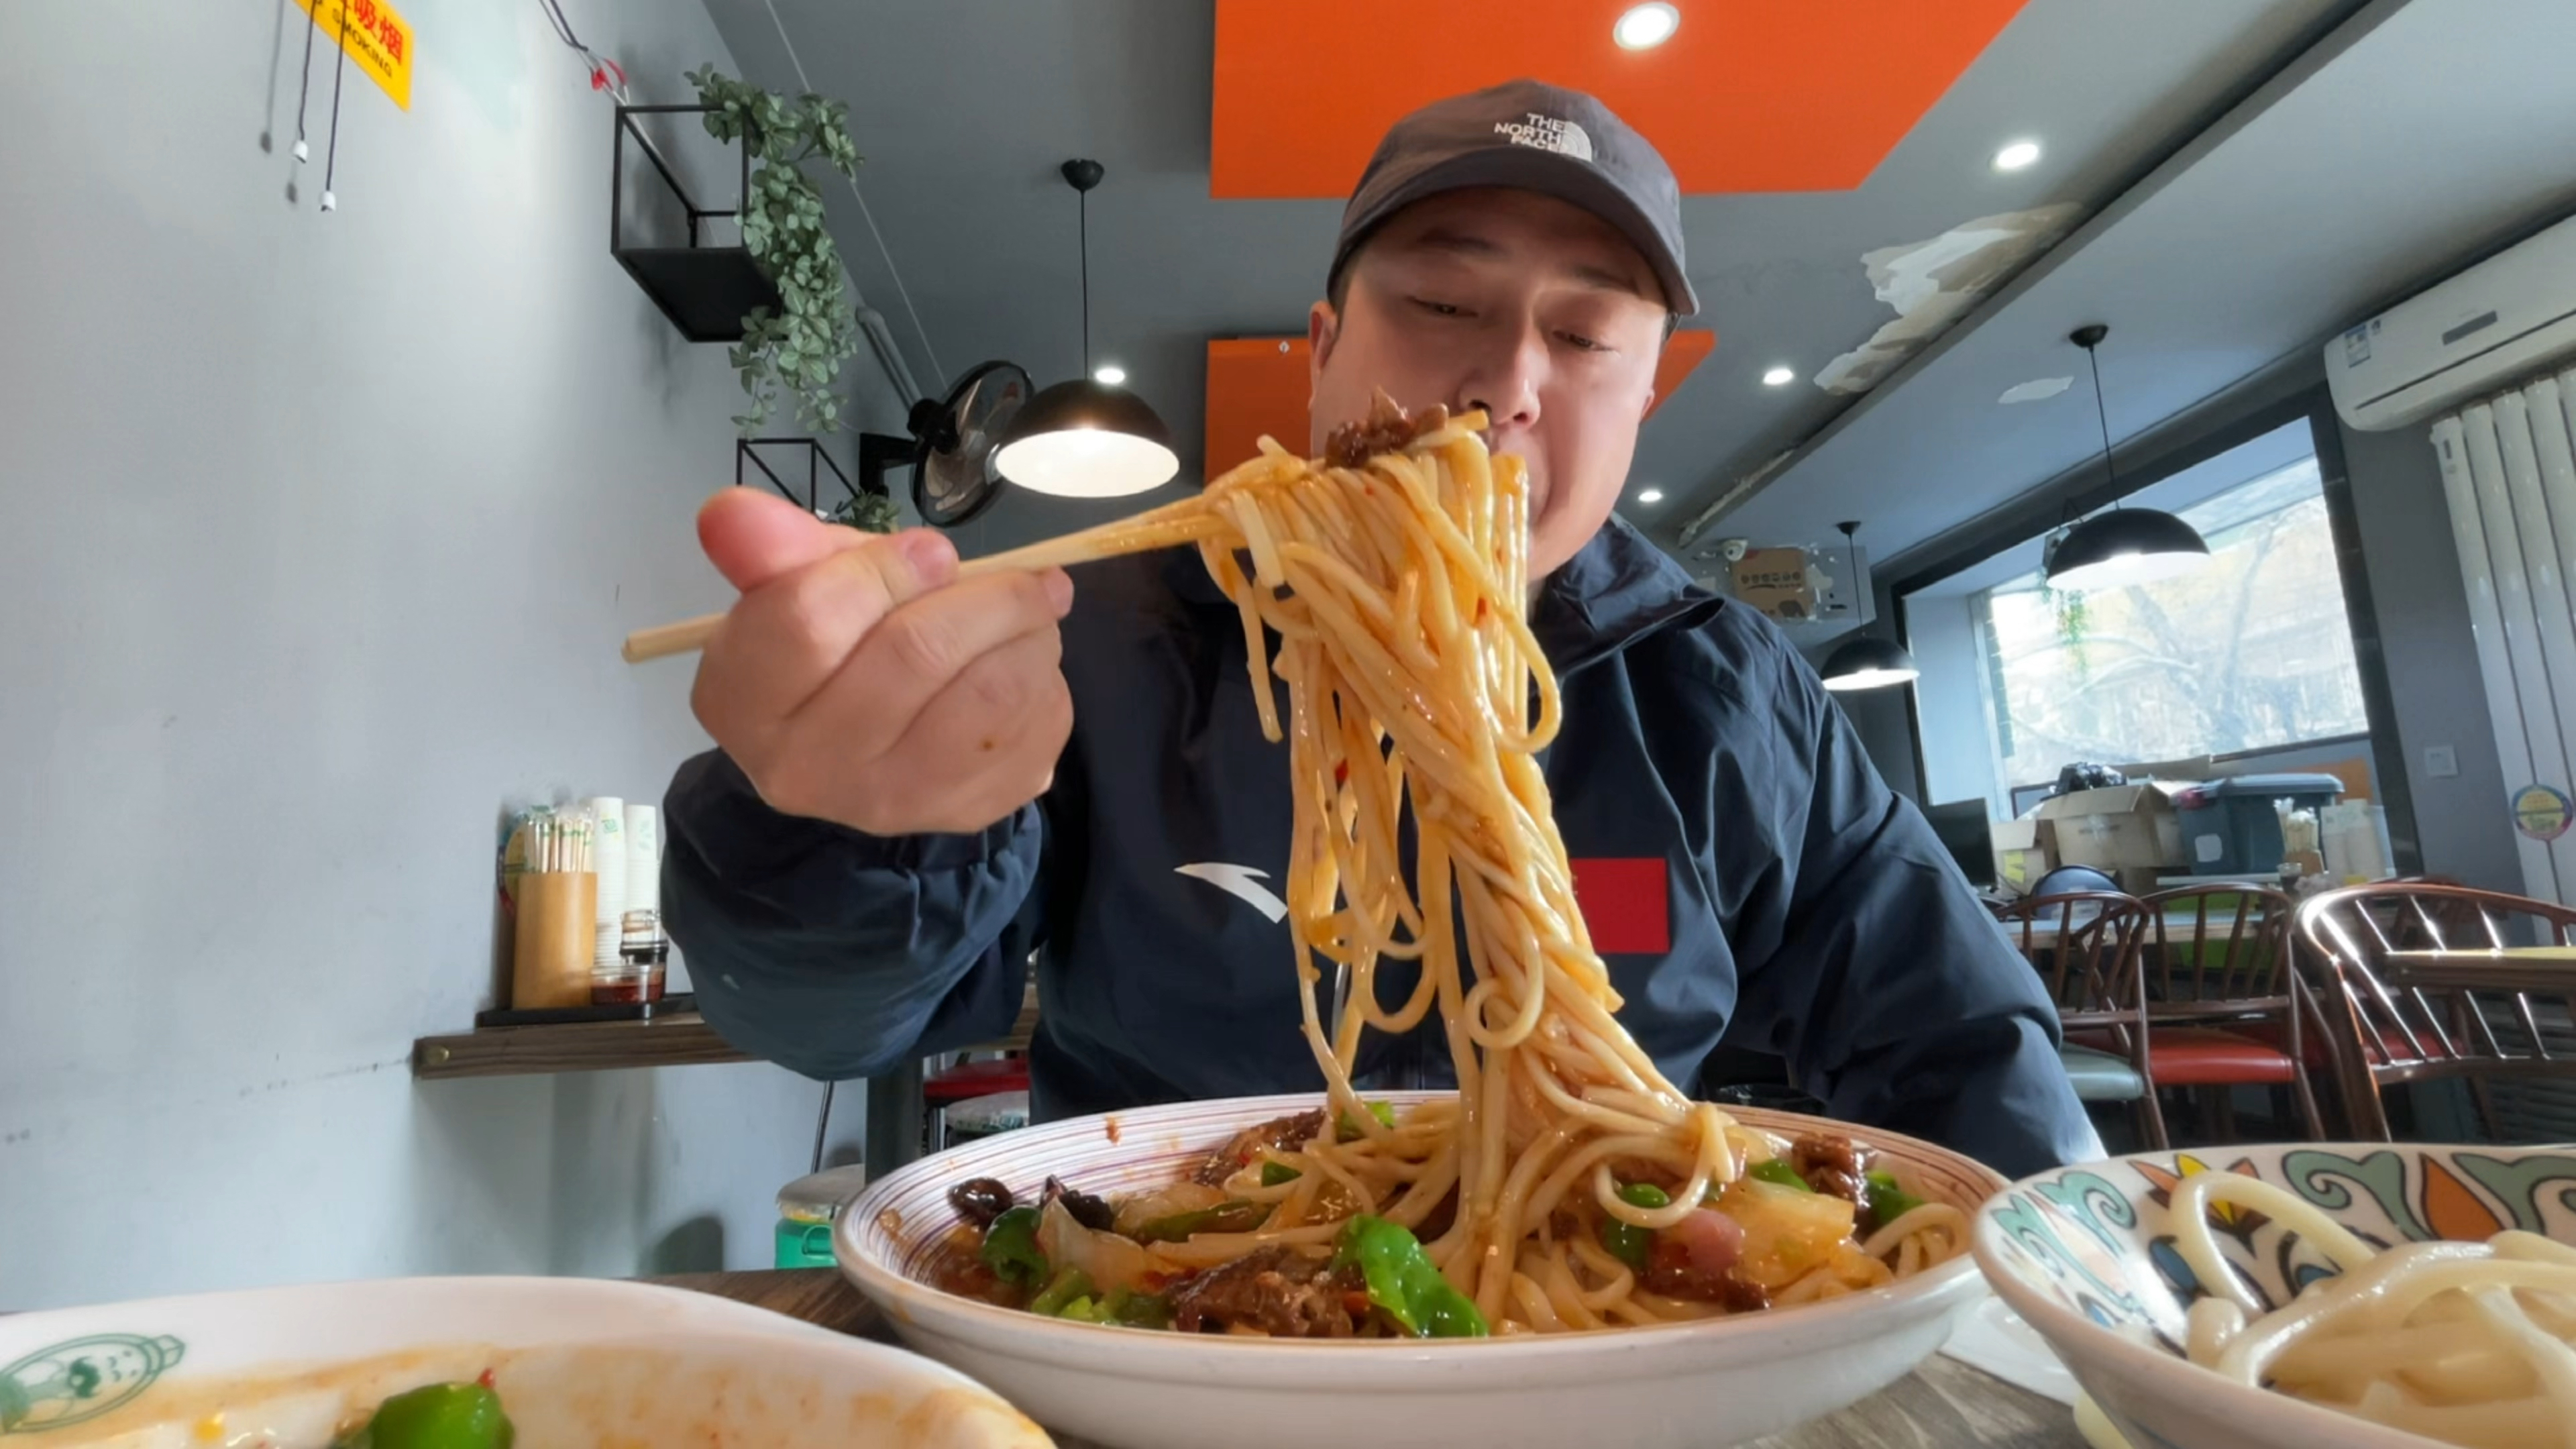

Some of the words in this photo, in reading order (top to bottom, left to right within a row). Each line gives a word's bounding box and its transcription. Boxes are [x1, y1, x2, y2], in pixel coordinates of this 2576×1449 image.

[345, 0, 402, 66] 吸烟
[1493, 122, 1562, 145] NORTH
[1527, 112, 1566, 133] THE
[1511, 134, 1560, 153] FACE
